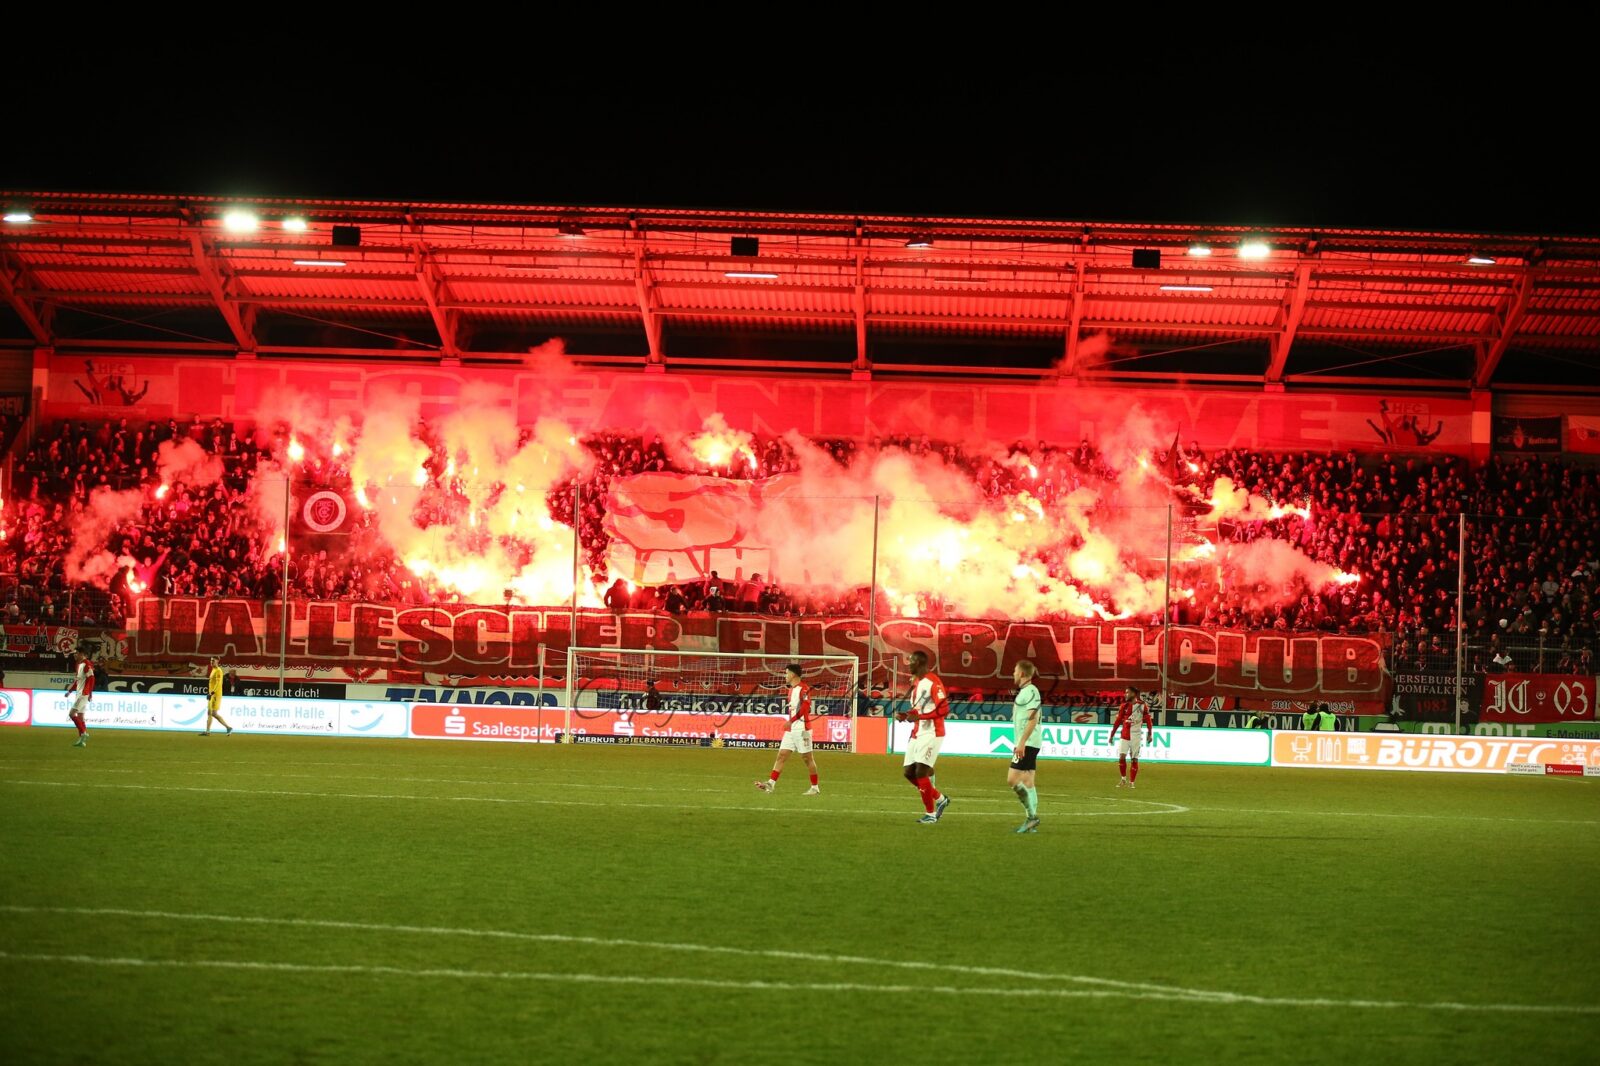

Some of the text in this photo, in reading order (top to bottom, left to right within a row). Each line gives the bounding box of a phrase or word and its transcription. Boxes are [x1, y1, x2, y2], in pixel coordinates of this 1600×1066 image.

[134, 597, 683, 672] HALLESCHER
[295, 688, 320, 698] dich!
[1553, 681, 1588, 715] 03
[118, 701, 148, 713] Halle
[230, 705, 325, 719] reha team Halle
[1377, 740, 1557, 768] BÜROTEC
